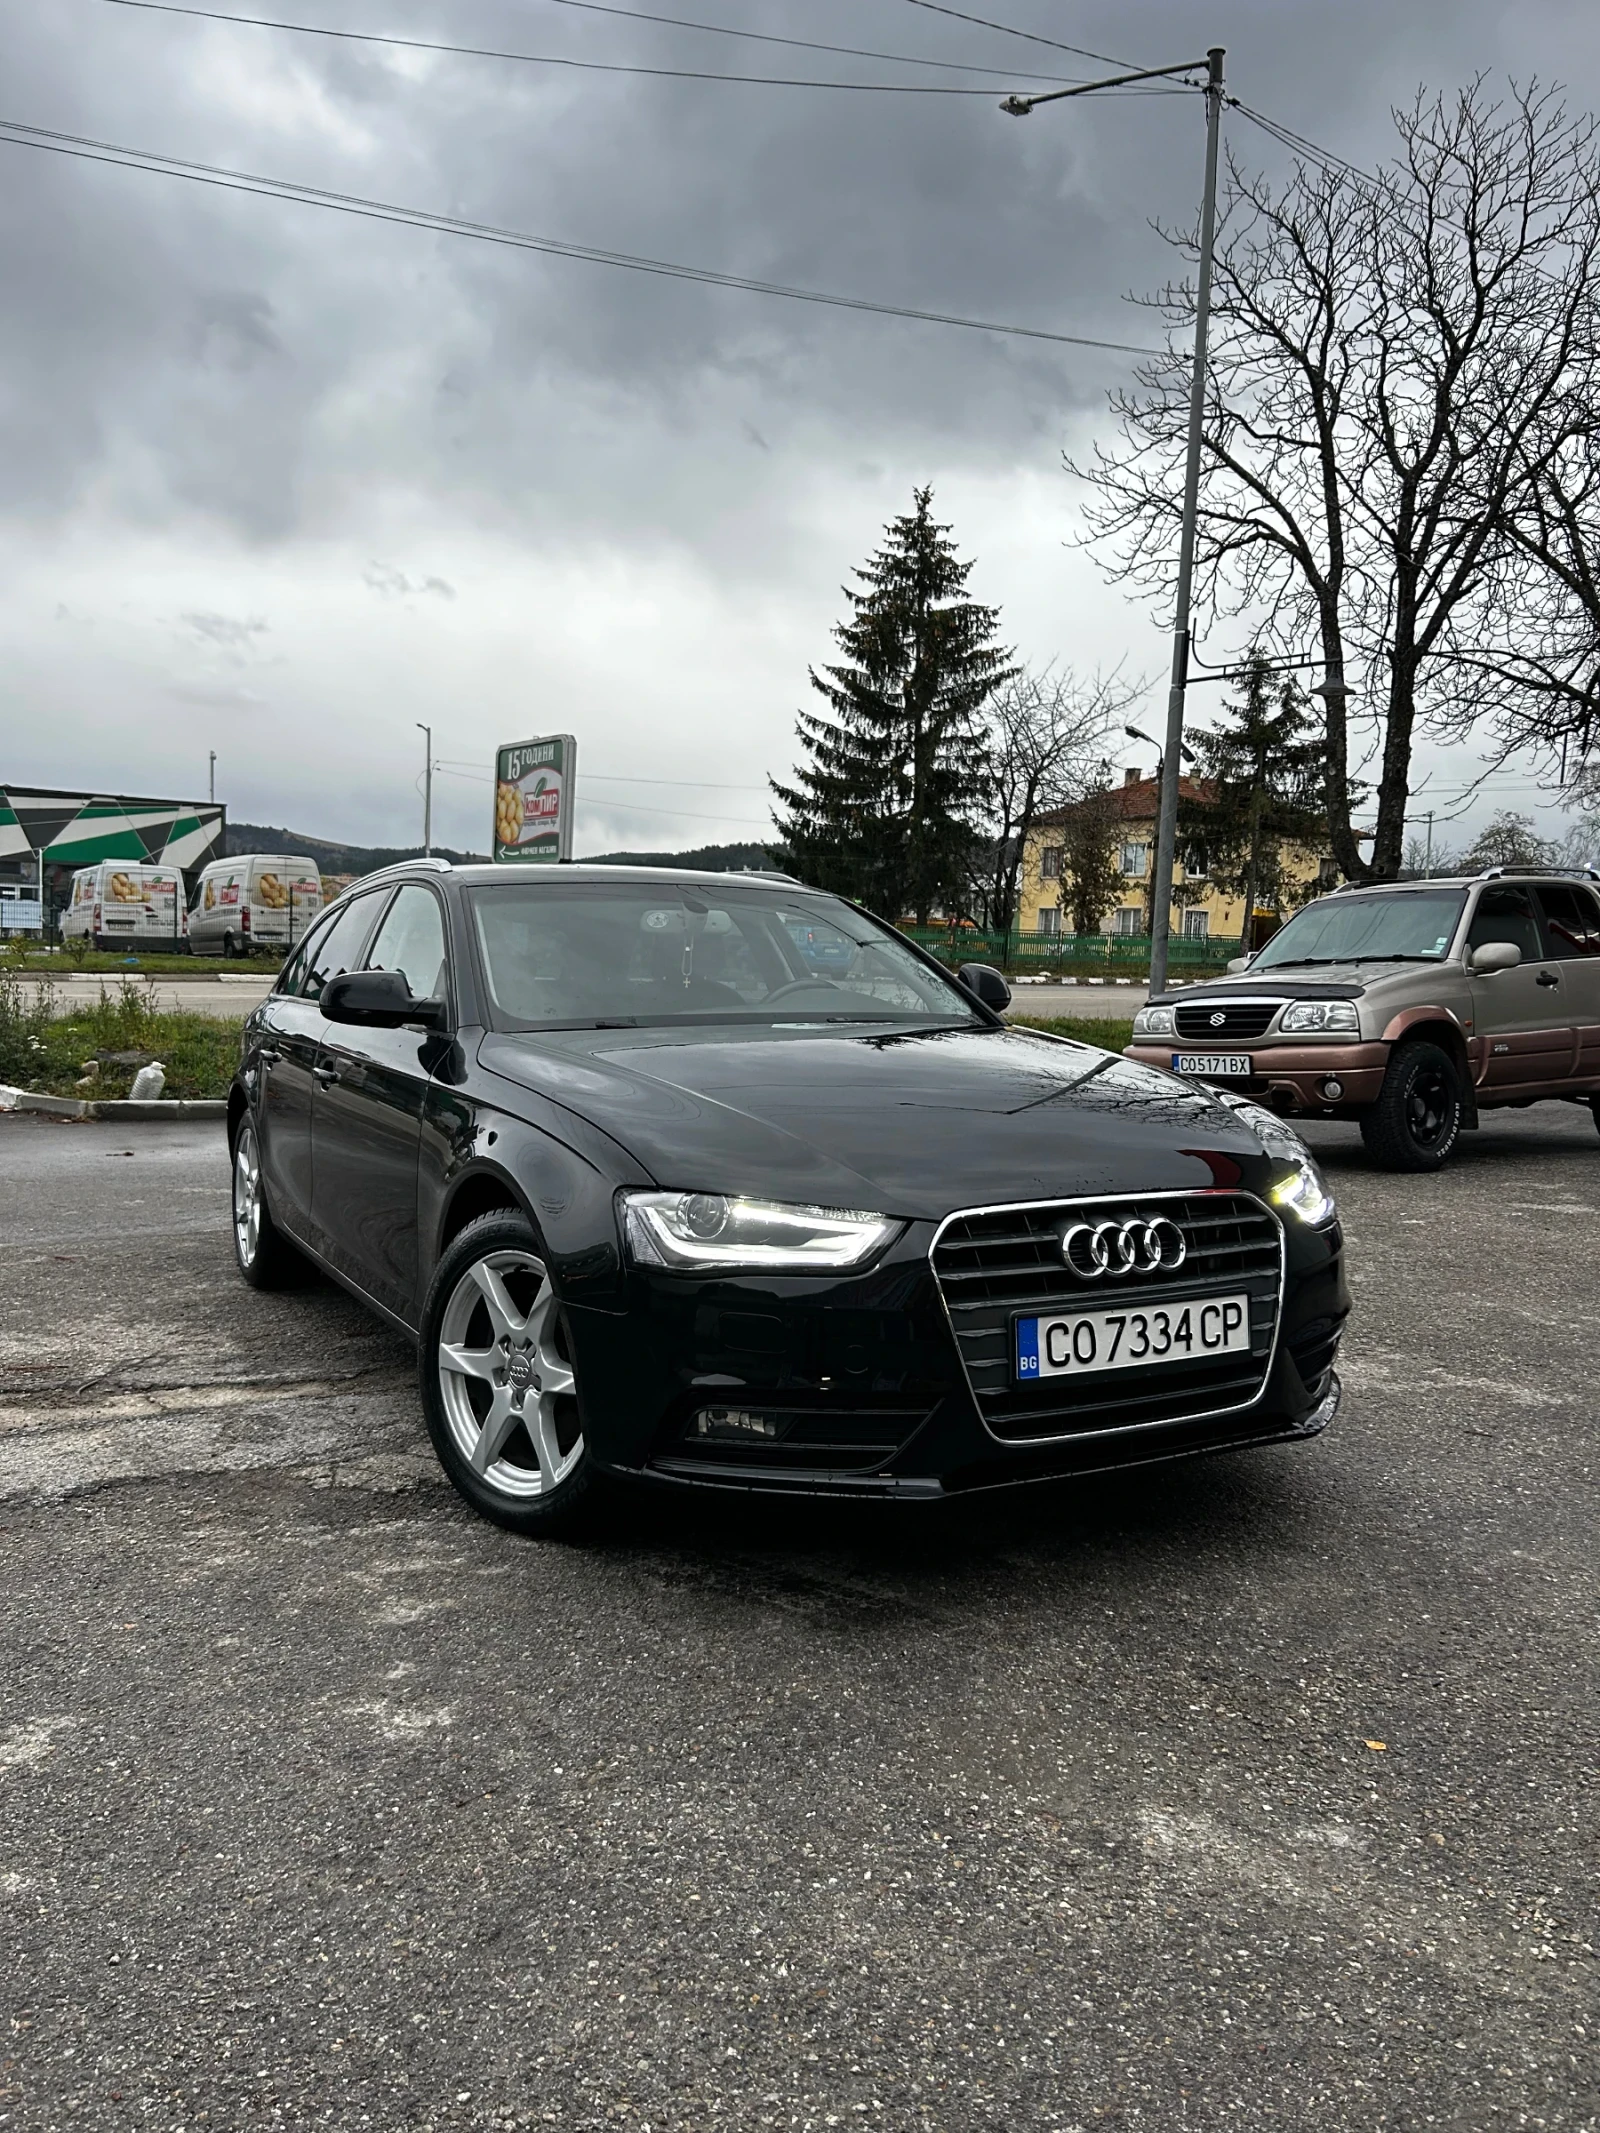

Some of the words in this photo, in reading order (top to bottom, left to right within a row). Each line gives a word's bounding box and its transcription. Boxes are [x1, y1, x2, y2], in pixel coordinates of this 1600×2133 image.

[507, 750, 520, 779] 15
[521, 745, 554, 766] ГОДИНИ
[1045, 1318, 1097, 1368] CO
[1105, 1307, 1194, 1363] 7334
[1200, 1301, 1243, 1349] CP
[1020, 1355, 1038, 1371] BG
